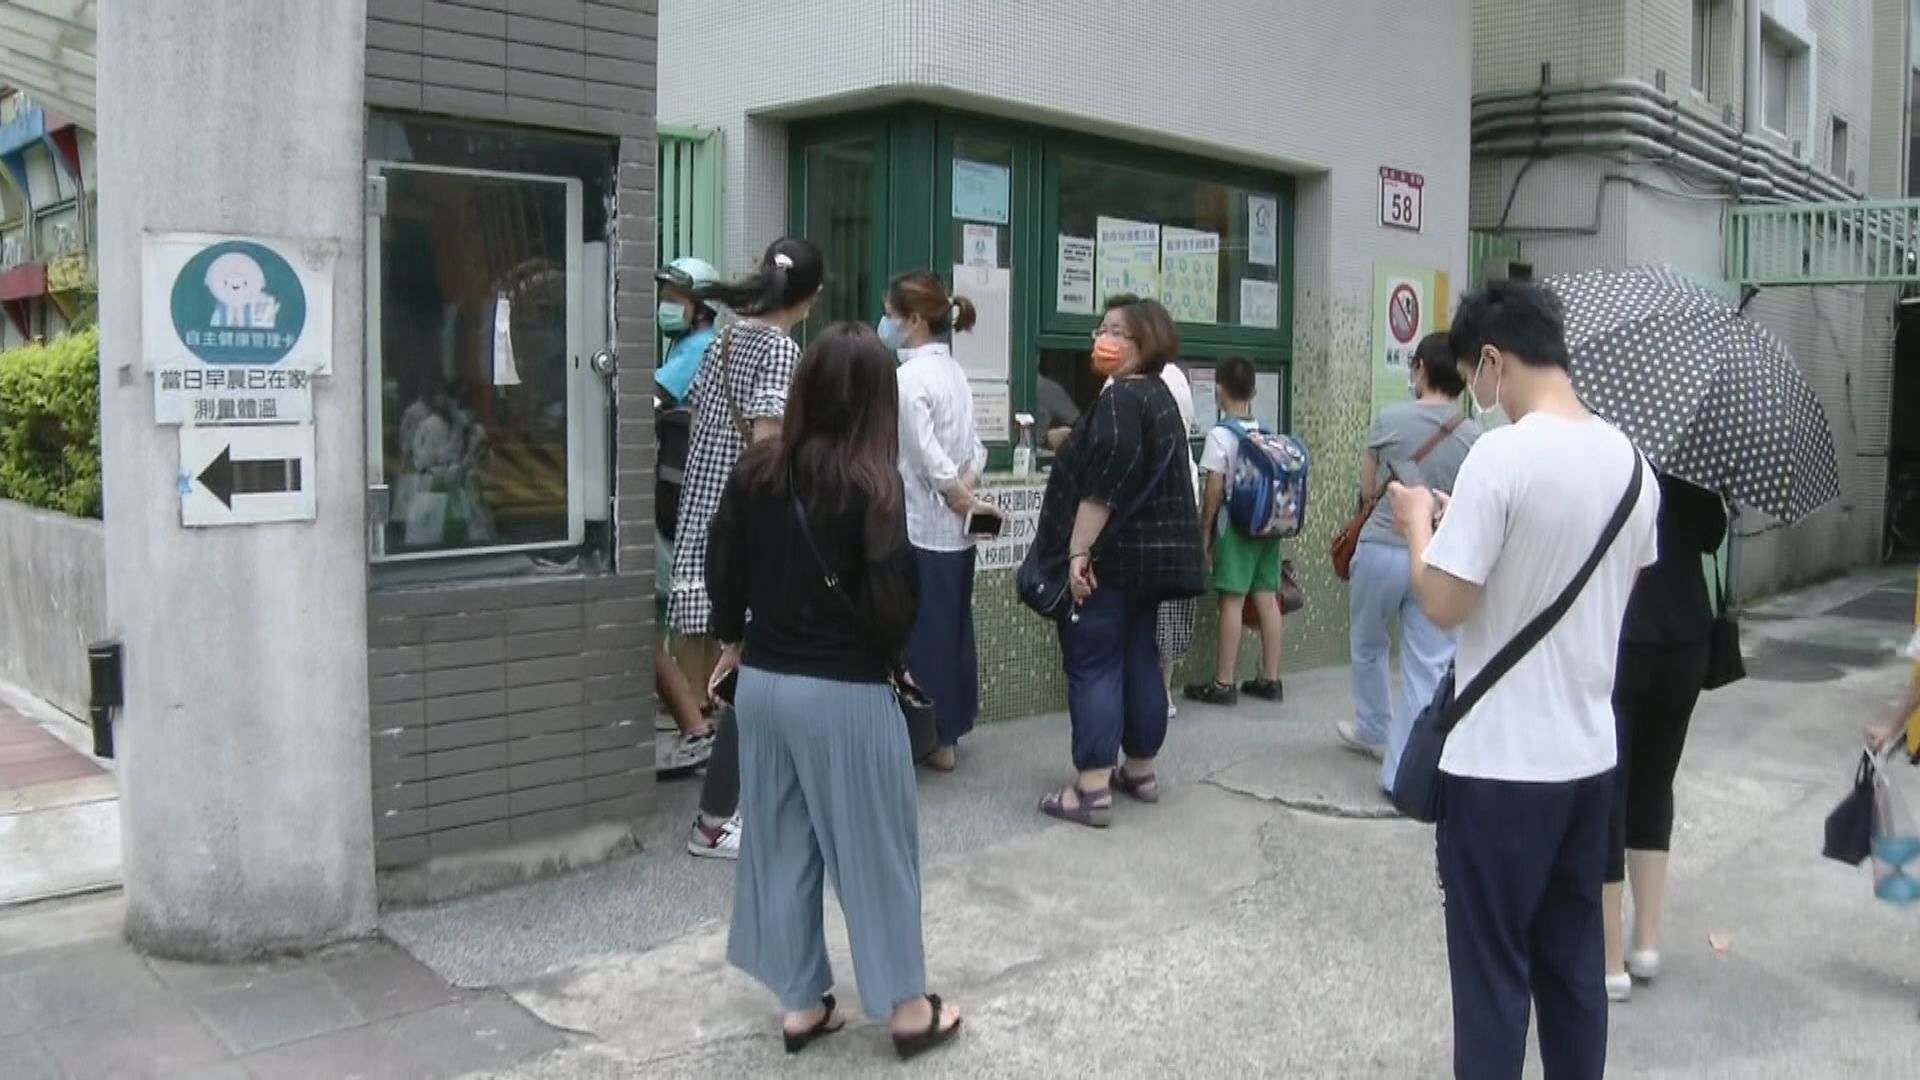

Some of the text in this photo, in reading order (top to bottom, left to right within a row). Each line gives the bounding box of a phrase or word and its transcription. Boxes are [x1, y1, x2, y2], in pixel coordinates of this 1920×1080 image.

[1392, 193, 1412, 223] 58
[185, 330, 294, 348] 自主健康管理卡
[160, 369, 308, 390] 當日早晨已在家
[194, 398, 277, 420] 測量體溫
[974, 490, 1041, 512] 校園防
